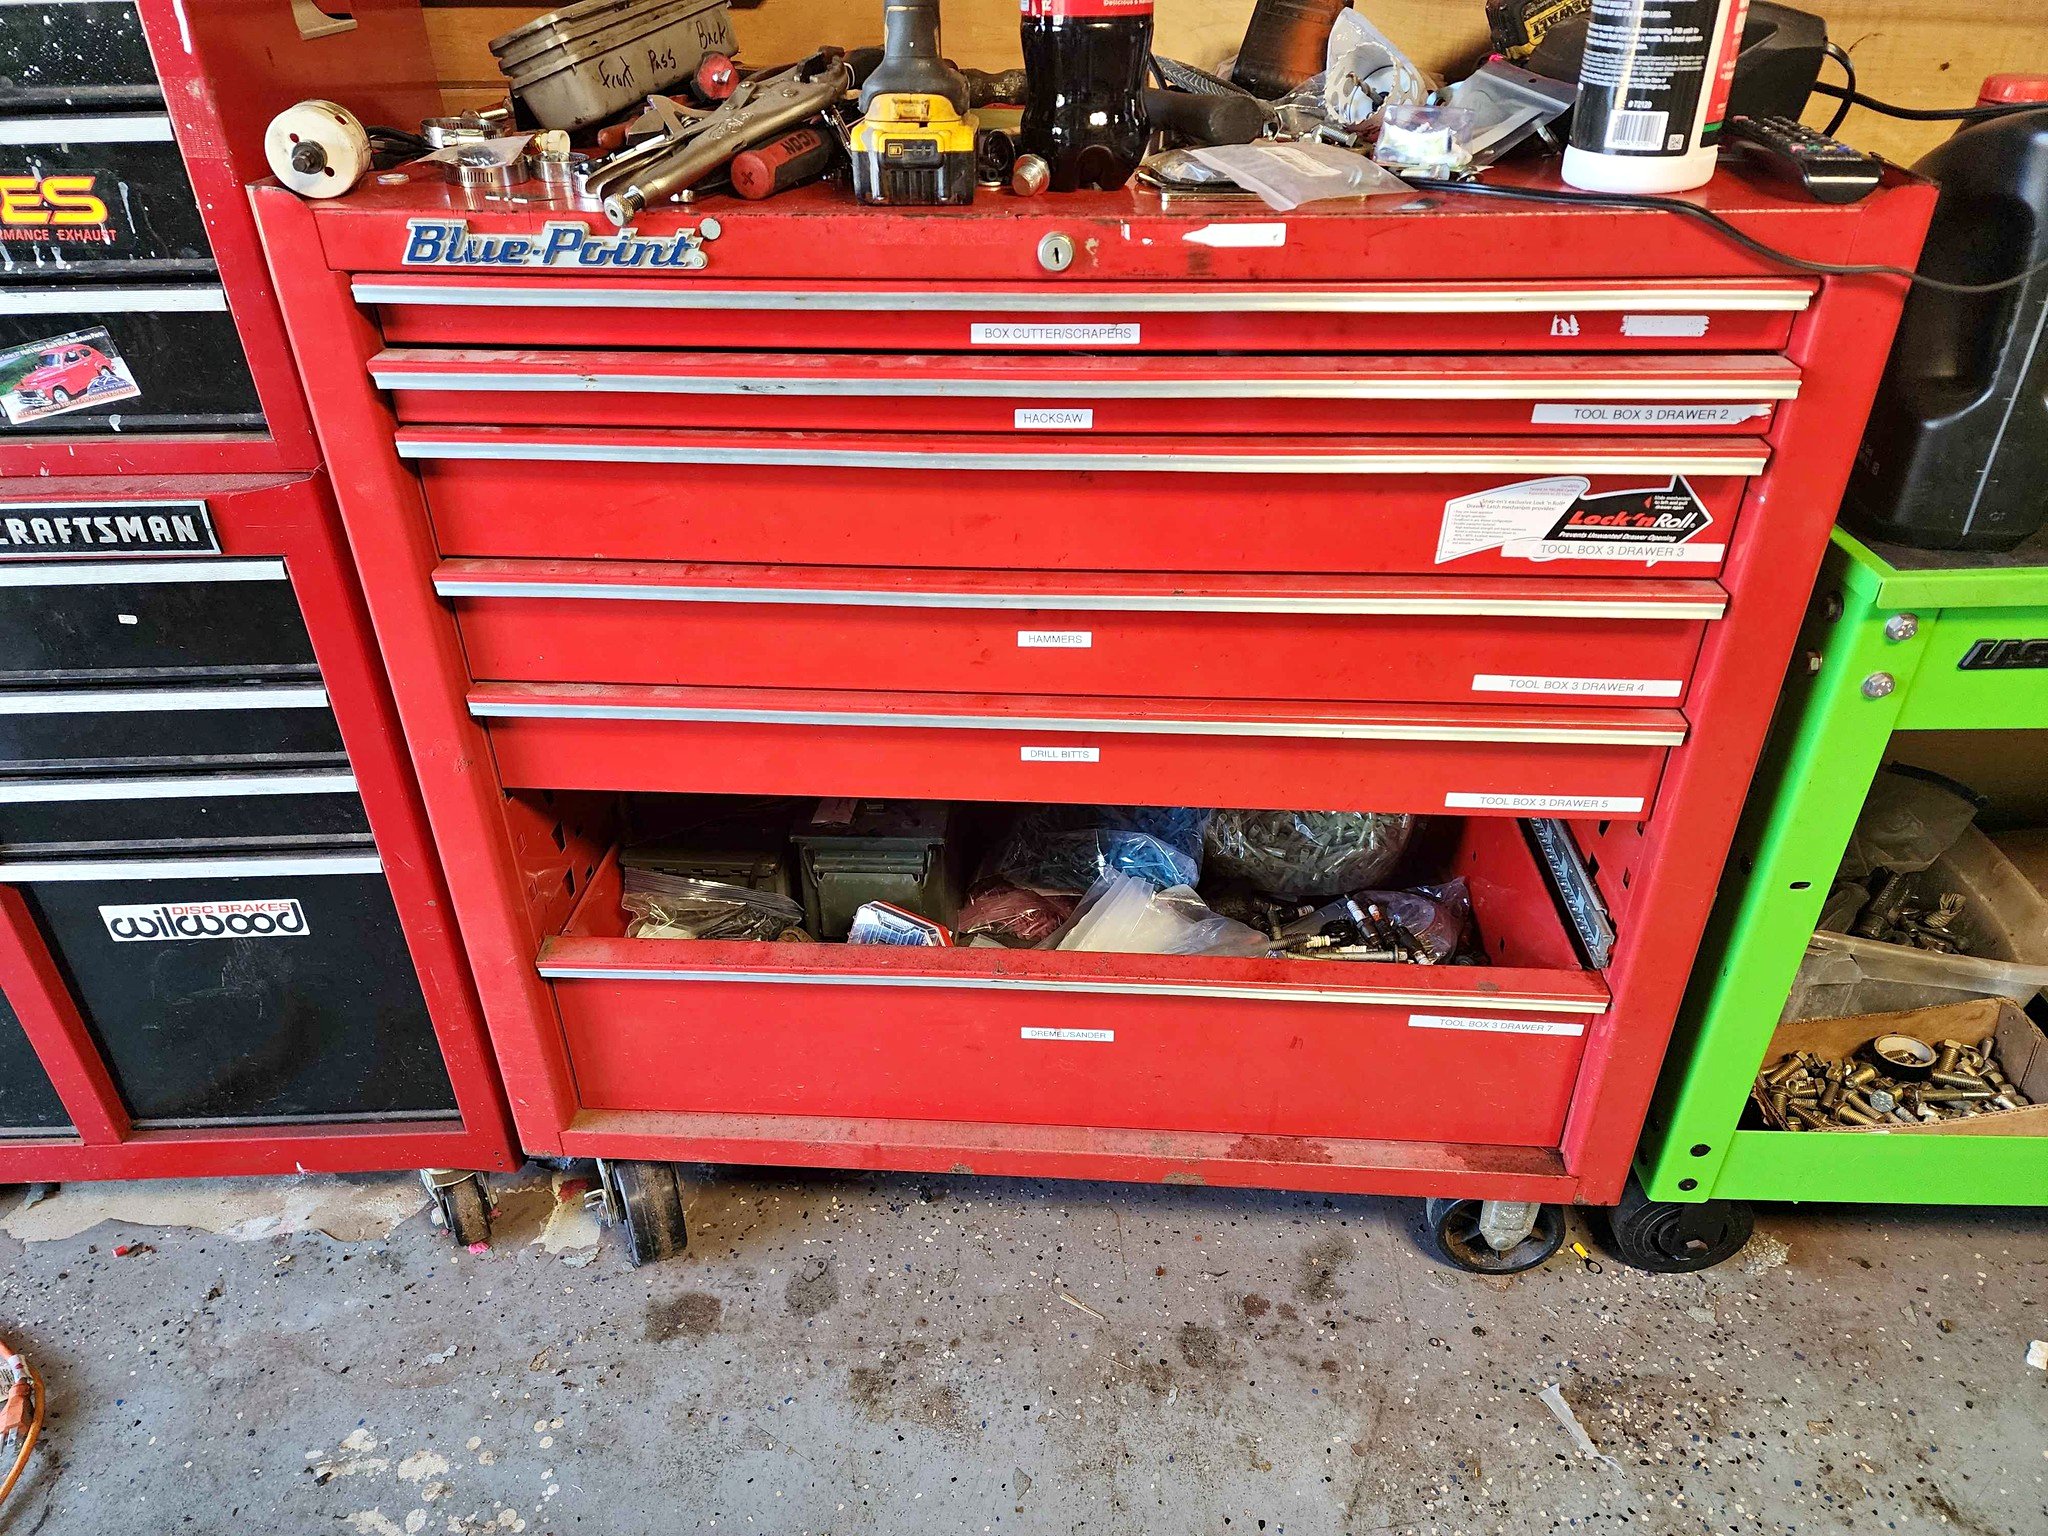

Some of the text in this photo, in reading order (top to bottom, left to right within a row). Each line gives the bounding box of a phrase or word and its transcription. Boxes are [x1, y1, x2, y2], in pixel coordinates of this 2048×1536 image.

[649, 49, 677, 74] Pass
[696, 21, 727, 49] Back
[404, 222, 699, 267] Blue-Point
[985, 328, 1131, 339] BOX CUTTER/SCRAPERS
[1024, 414, 1083, 424] HACKSAW
[1574, 409, 1729, 420] TOOL BOX 3 DRAWER 2
[1653, 512, 1698, 528] Roll
[1587, 532, 1623, 540] Unwanted
[1647, 534, 1677, 542] Opening
[1541, 544, 1685, 557] TOOL BOX 3 DRAWER 3
[1028, 635, 1083, 643] HAMMERS
[1509, 679, 1645, 692] TOOL BOX 3 DRAWER 4
[1030, 749, 1089, 758] DRILL BITTS
[1480, 796, 1609, 808] TOOL BOX 3 DRAWER 5
[172, 902, 290, 915] DISC BRAKES
[110, 902, 304, 939] wilwood
[1440, 1018, 1466, 1027] TOOL
[1468, 1020, 1489, 1028] BOX
[1491, 1021, 1498, 1029] 3
[1500, 1022, 1544, 1031] DRAWER
[1031, 1030, 1106, 1039] DREMEL/SANDER
